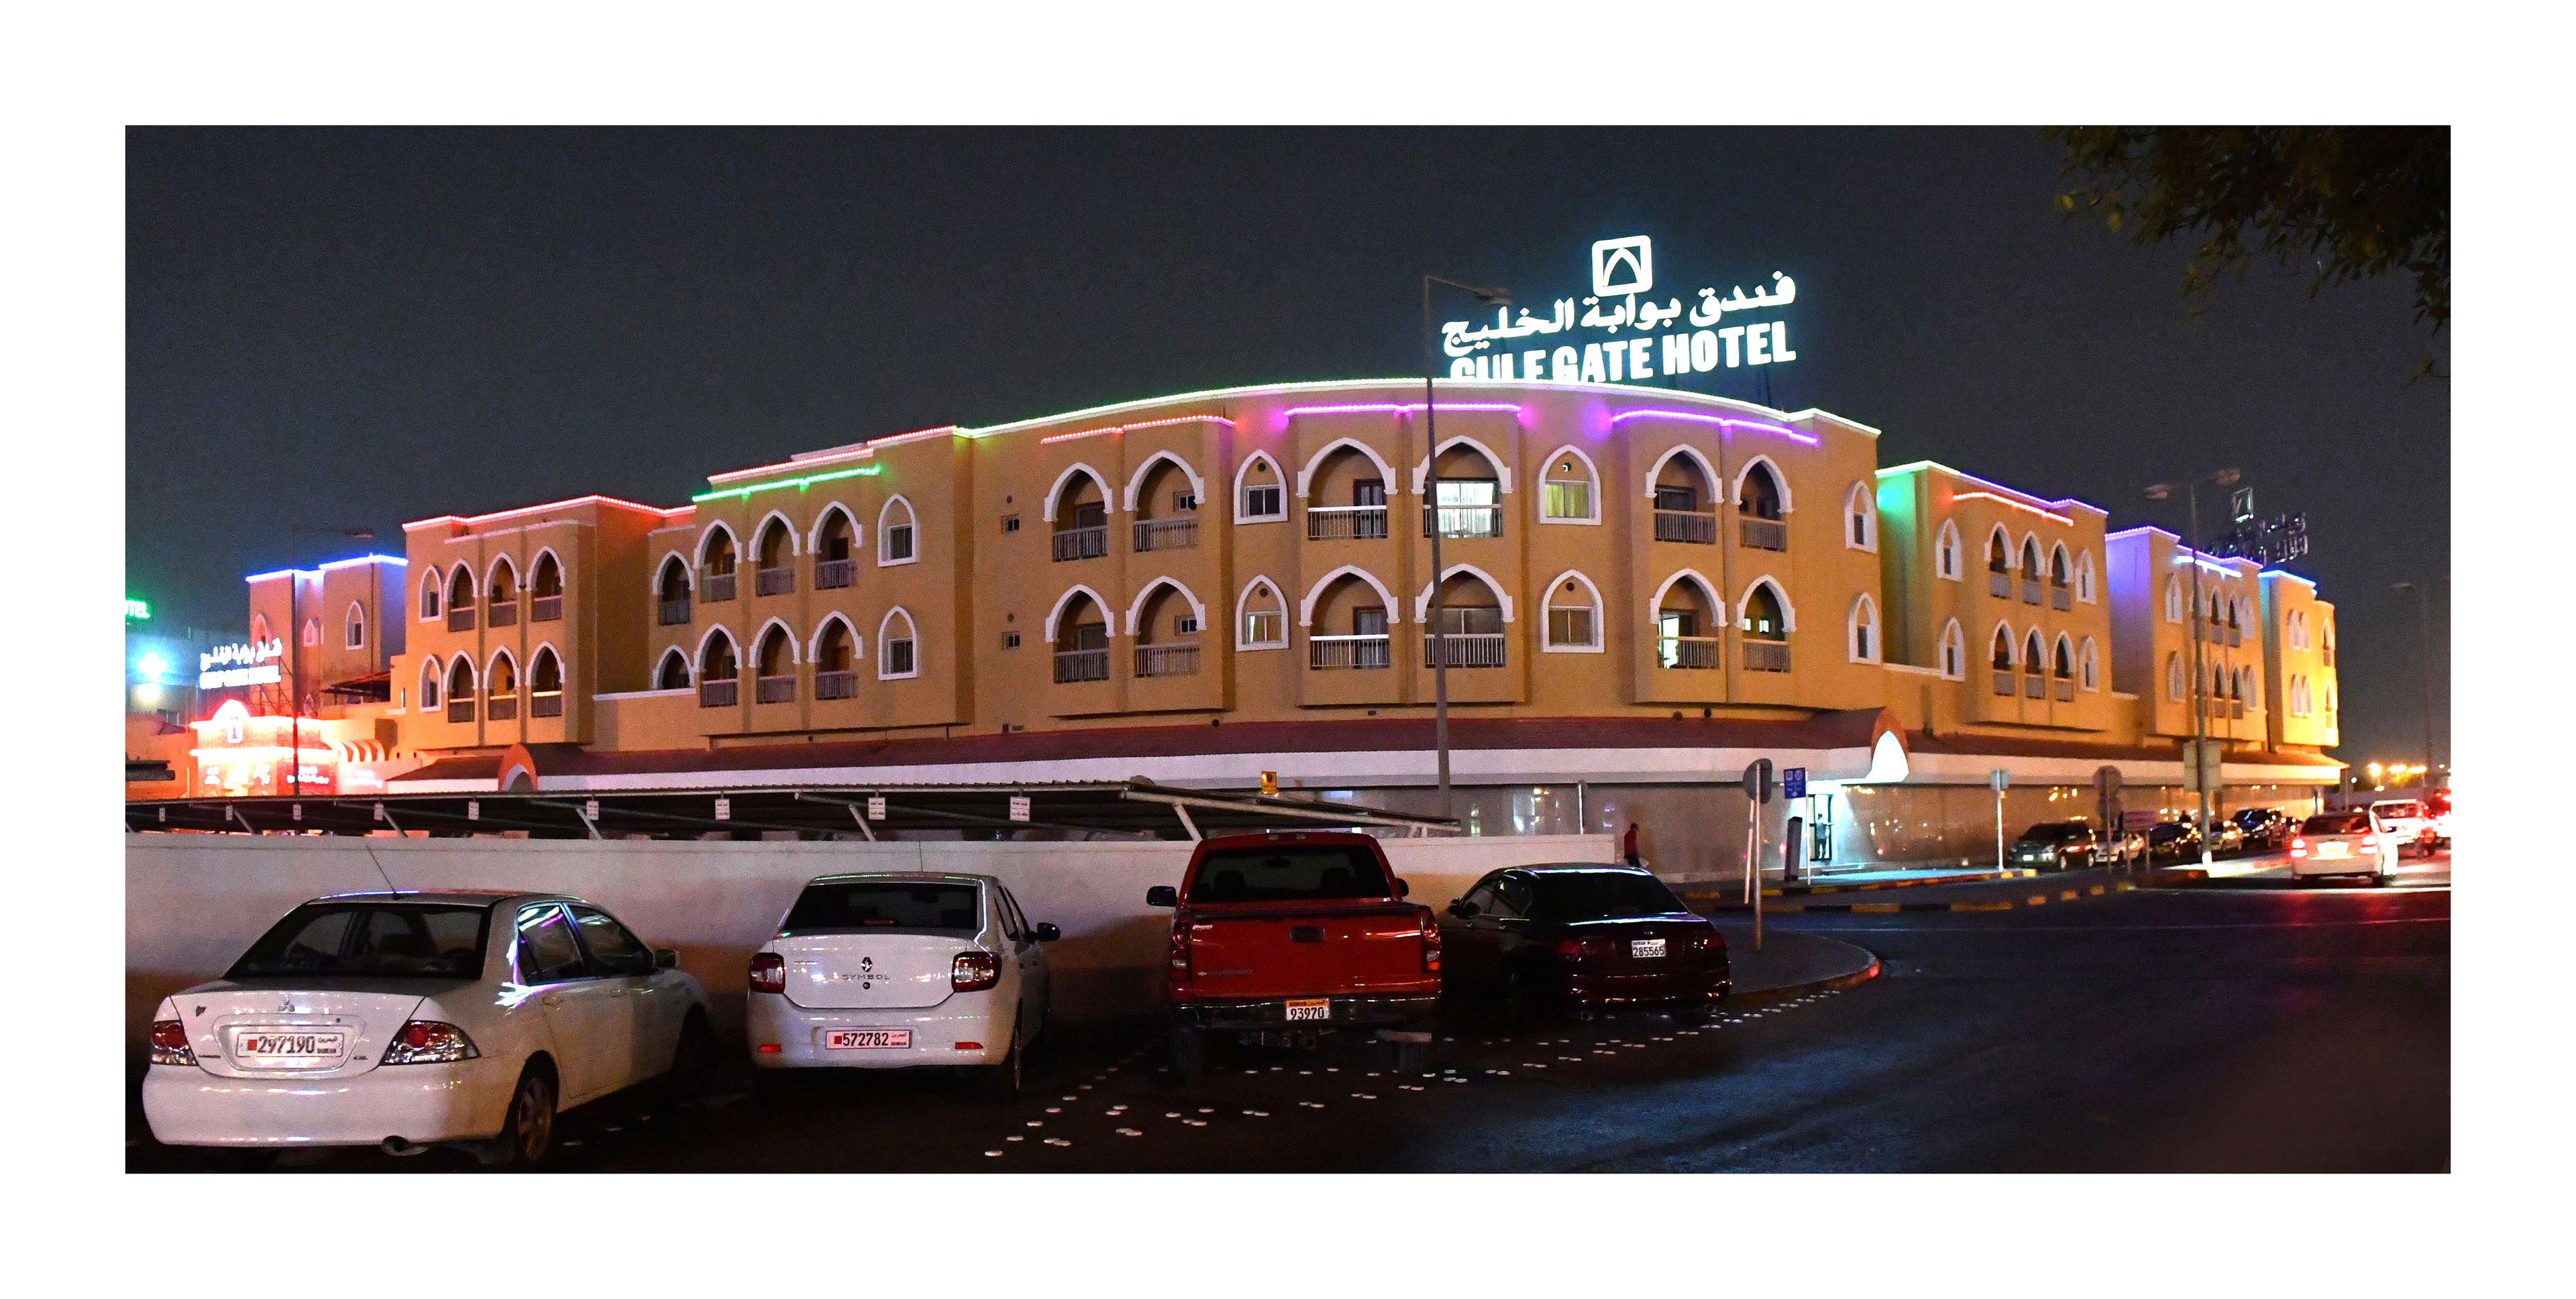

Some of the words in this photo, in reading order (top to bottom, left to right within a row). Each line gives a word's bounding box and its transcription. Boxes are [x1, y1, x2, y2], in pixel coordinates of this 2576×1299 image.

[1580, 293, 1681, 333] بوابة
[1690, 271, 1796, 326] فندق
[1442, 297, 1575, 357] الخليج
[1552, 338, 1653, 384] GATE
[1662, 321, 1796, 376] HOTEL
[1633, 946, 1664, 957] 285565
[1290, 1007, 1324, 1019] 93970
[258, 1035, 315, 1054] 297190
[843, 1032, 889, 1046] 572782
